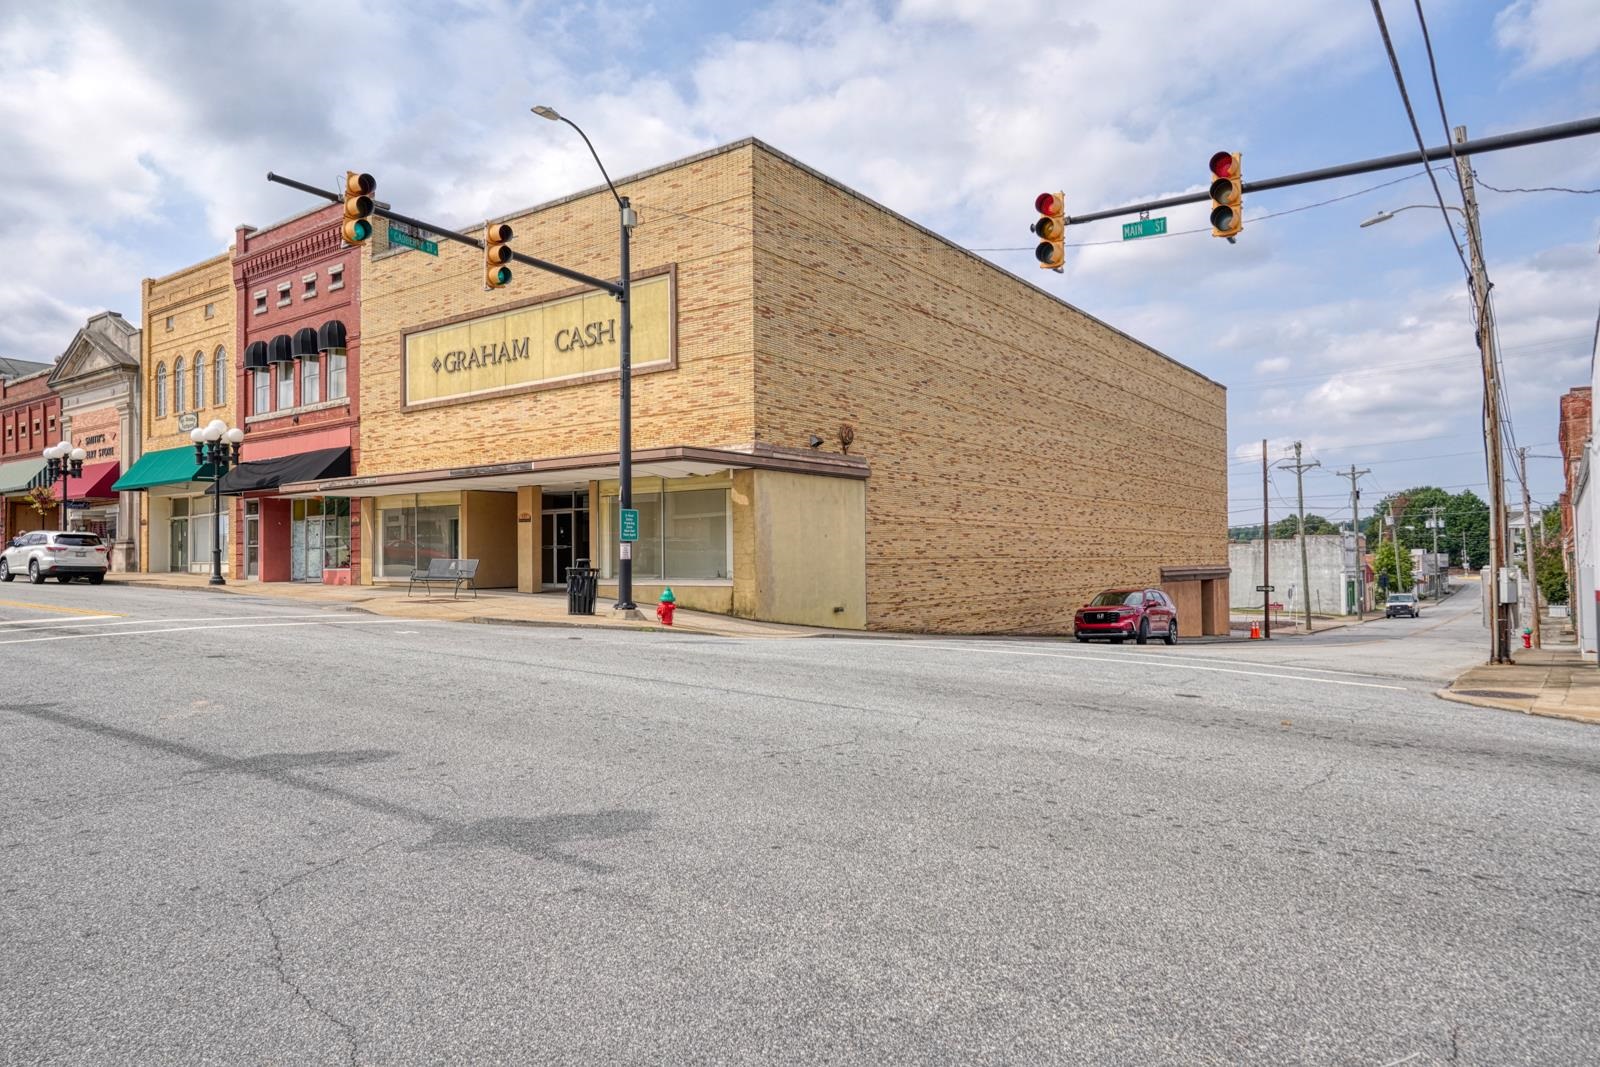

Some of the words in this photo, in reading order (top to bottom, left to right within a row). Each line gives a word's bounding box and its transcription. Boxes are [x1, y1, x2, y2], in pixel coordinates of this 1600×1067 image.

[1124, 223, 1143, 237] MAIN
[1155, 219, 1164, 232] ST
[443, 337, 530, 374] GRAHAM
[554, 318, 616, 353] CASH
